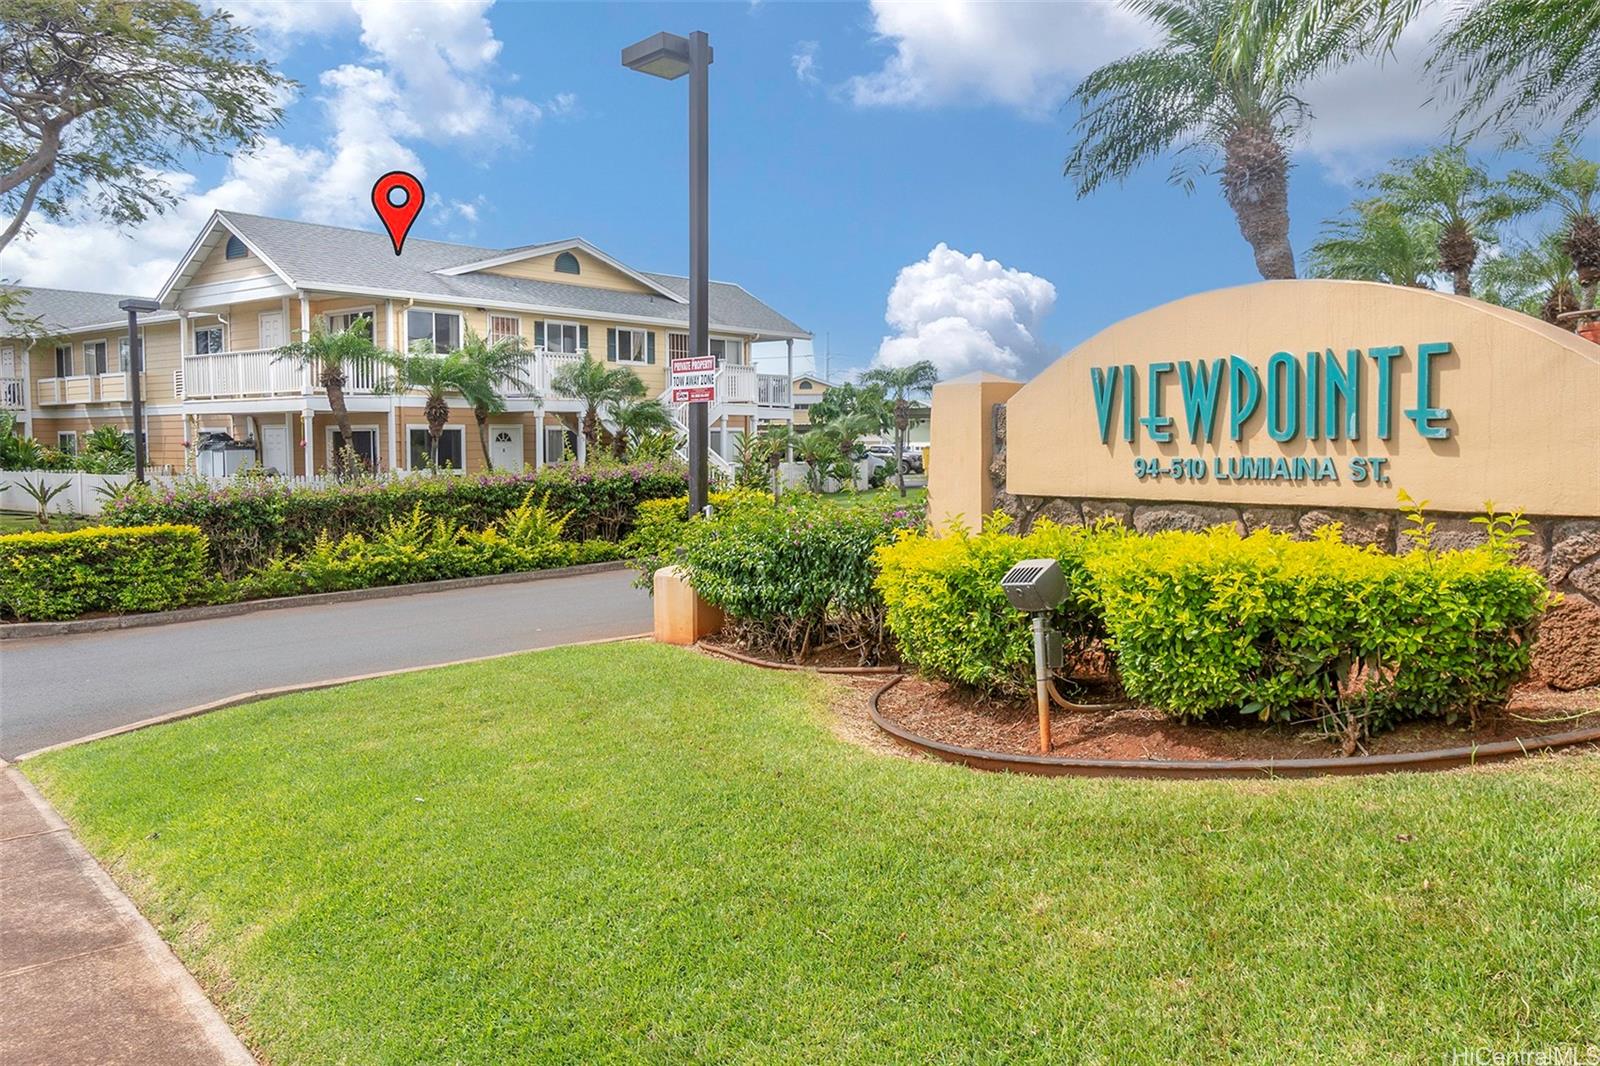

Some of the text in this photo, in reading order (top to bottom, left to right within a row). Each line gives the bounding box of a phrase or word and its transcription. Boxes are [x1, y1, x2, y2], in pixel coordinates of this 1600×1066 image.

[674, 359, 713, 371] PRIVATE PROPERTY
[673, 373, 714, 387] TOW AWAY ZONE
[1090, 341, 1453, 445] VIEWPOINTE
[1134, 456, 1390, 483] 94-510 LUMIAINA ST.
